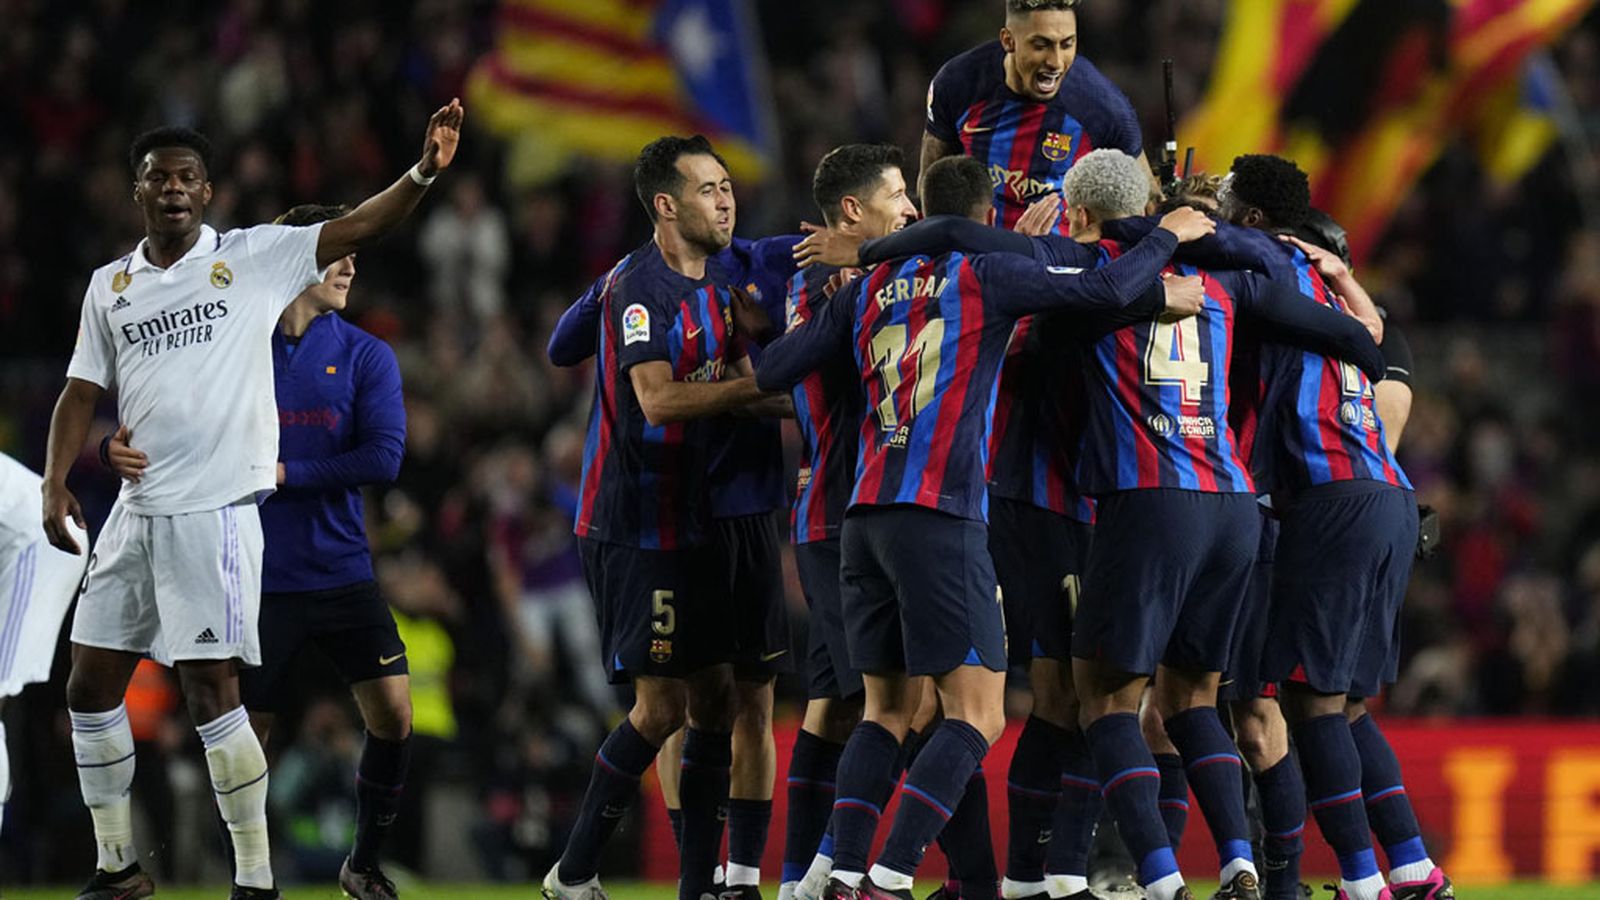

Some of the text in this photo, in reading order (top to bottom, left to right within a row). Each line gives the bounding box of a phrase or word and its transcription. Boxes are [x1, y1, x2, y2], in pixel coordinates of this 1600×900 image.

[121, 299, 228, 345] Emirates
[142, 324, 213, 358] FLY BETTER
[1144, 315, 1209, 406] 4
[1177, 415, 1213, 426] UNHCR
[1178, 425, 1215, 436] ACNUR
[651, 589, 675, 635] 5
